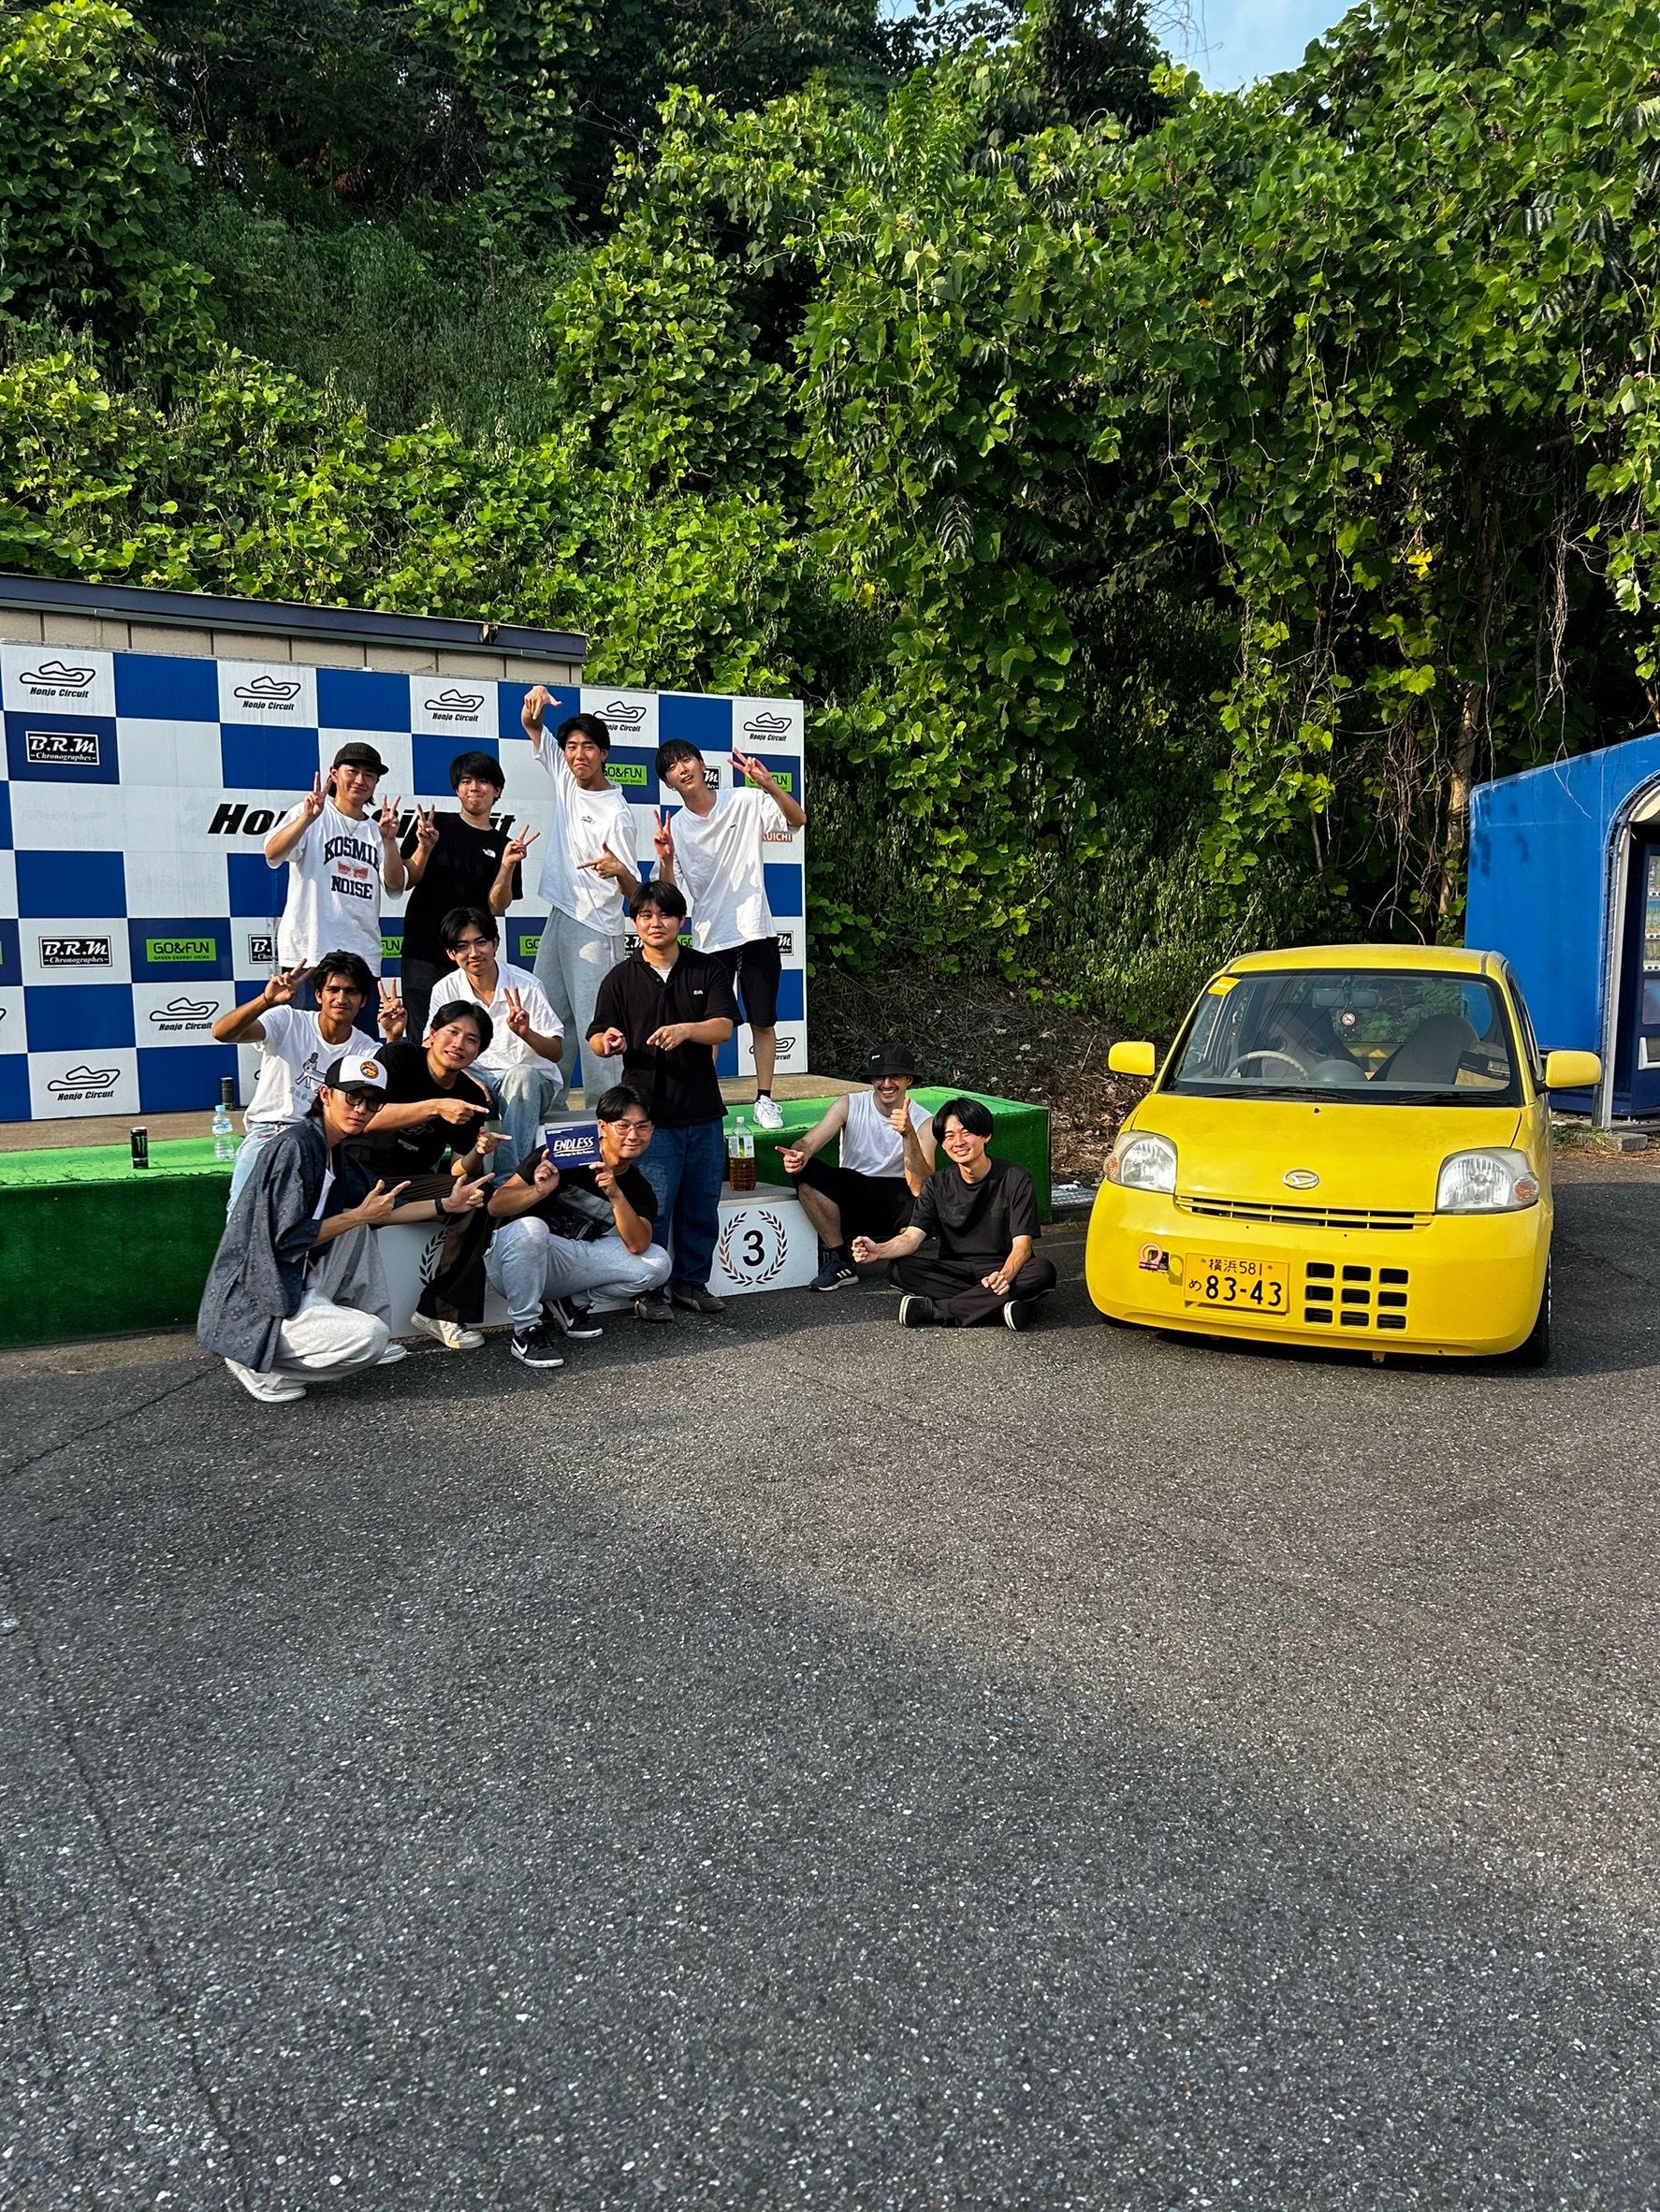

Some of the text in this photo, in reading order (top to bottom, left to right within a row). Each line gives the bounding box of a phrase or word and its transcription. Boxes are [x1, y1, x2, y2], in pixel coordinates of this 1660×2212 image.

[30, 687, 89, 698] Honjo Circuit
[243, 701, 295, 711] Honjo Circuit
[432, 712, 453, 720] Honjo
[331, 875, 372, 899] NOISE
[153, 941, 210, 954] GO&FUN
[185, 1022, 212, 1030] Circuit
[85, 1090, 114, 1099] Circuit
[553, 1136, 594, 1152] ENDLESS
[742, 1230, 765, 1267] 3
[1188, 1274, 1282, 1307] め 83-43
